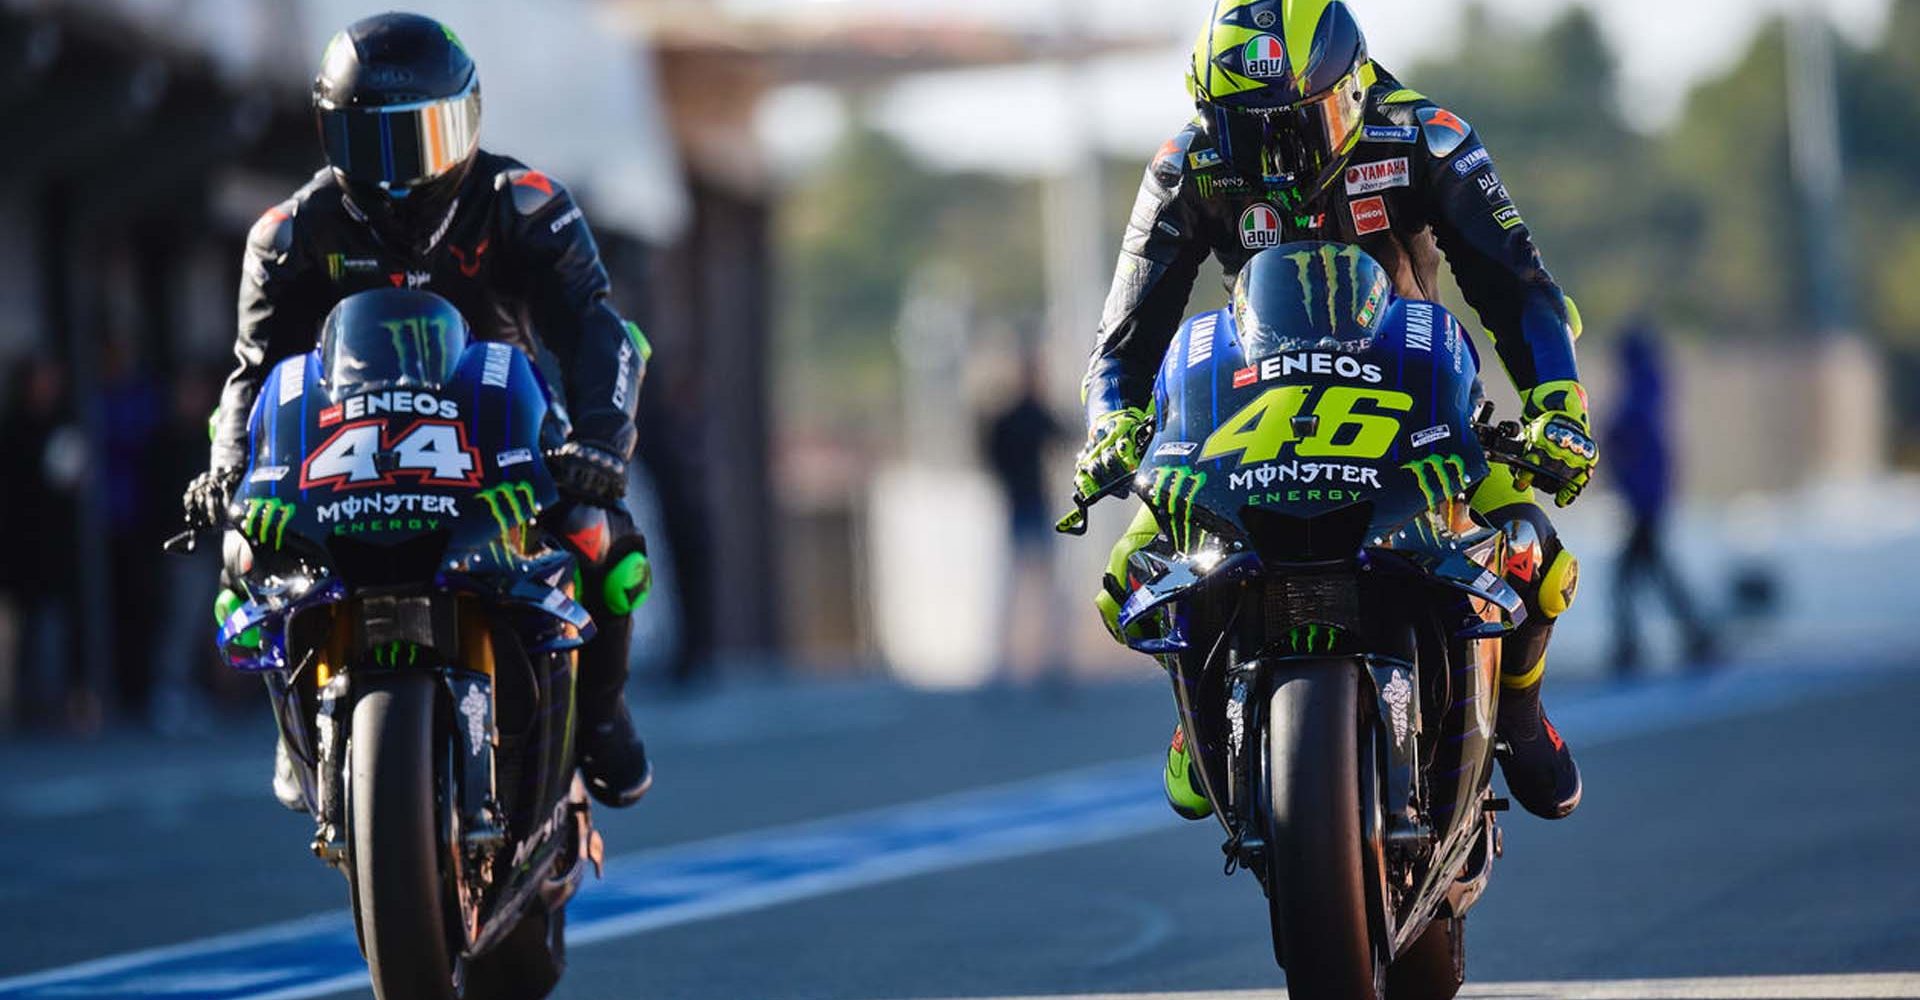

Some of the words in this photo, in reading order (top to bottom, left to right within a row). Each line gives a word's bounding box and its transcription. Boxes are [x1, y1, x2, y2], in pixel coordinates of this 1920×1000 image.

[1249, 59, 1281, 76] agv
[1368, 128, 1412, 138] MICHELIN
[1360, 159, 1407, 181] YAMAHA
[1356, 208, 1383, 221] ENEOS
[1247, 230, 1277, 246] agv
[1406, 303, 1433, 351] YAMAHA
[1261, 352, 1383, 383] ENEOS
[345, 390, 459, 420] ENEOS
[1200, 385, 1413, 464] 46
[303, 420, 481, 489] 44
[1229, 460, 1382, 490] MONSTER
[316, 492, 460, 523] MONSTER
[1248, 489, 1361, 506] ENERGY
[334, 518, 440, 535] ENERGY
